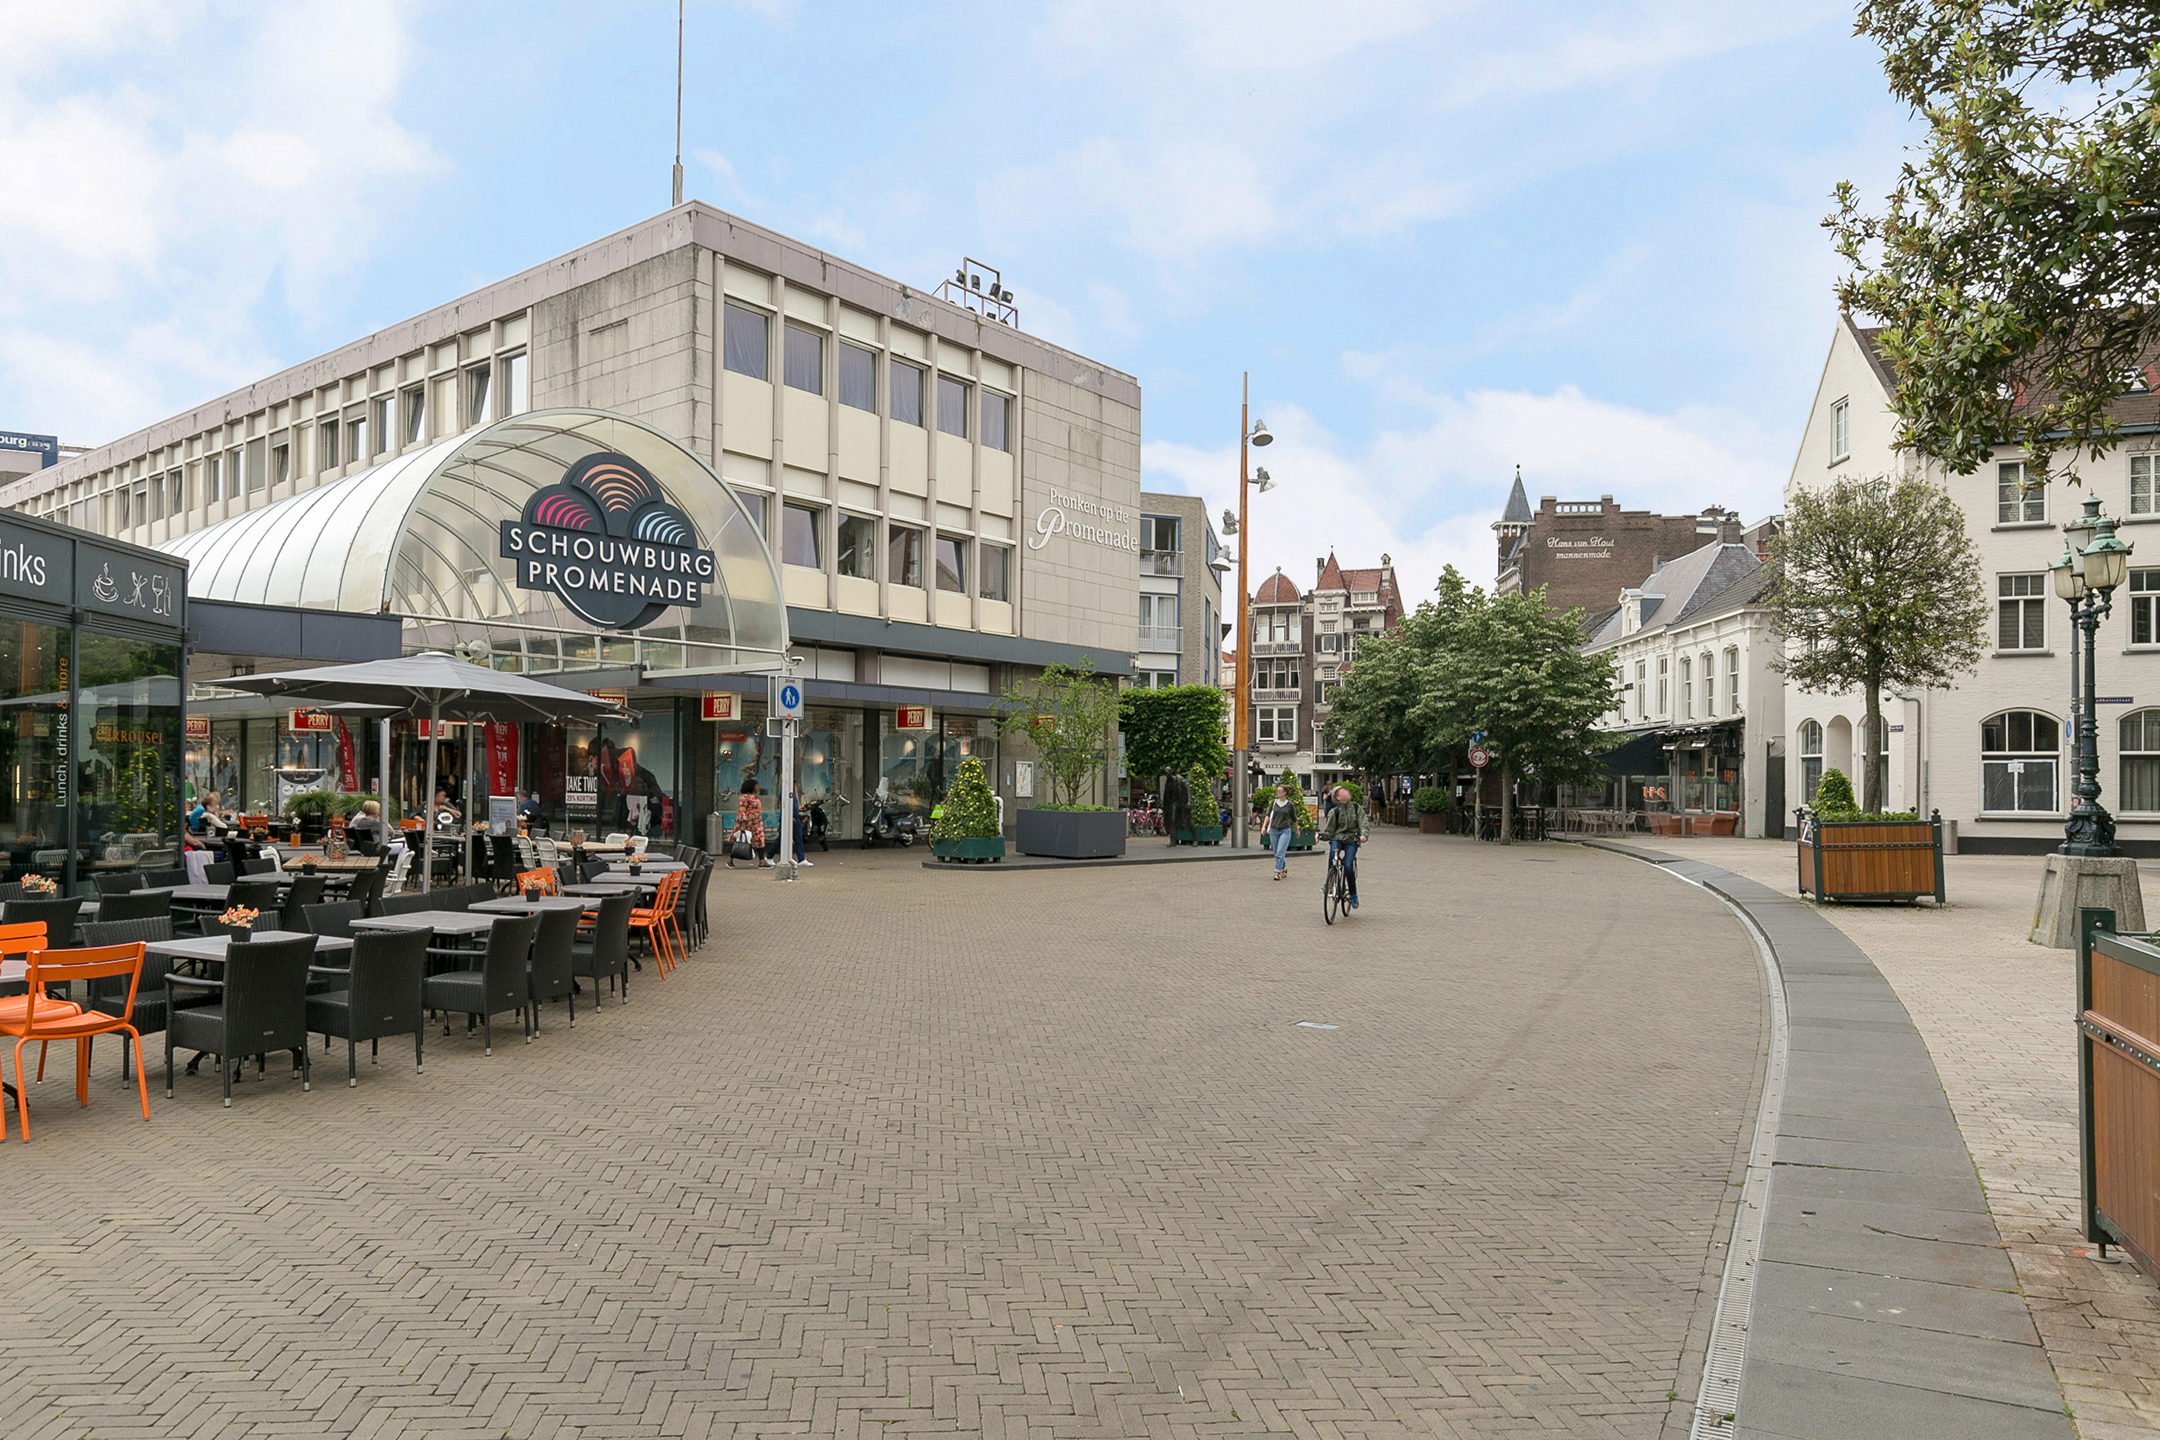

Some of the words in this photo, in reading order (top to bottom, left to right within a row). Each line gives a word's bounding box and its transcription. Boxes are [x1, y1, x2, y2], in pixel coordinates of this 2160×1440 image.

[1049, 487, 1097, 516] Pronken
[1100, 504, 1114, 523] op
[1116, 505, 1129, 524] de
[1027, 506, 1139, 552] Promenade
[1546, 536, 1572, 548] Hans
[509, 527, 713, 577] SCHOUWBURG
[1555, 548, 1612, 559] mannenmode
[528, 560, 698, 608] PROMENADE
[58, 657, 68, 693] more
[56, 700, 68, 710] &
[713, 699, 730, 714] PERRY
[186, 720, 206, 731] PERRY
[307, 714, 328, 726] PERRY
[907, 711, 924, 724] PERRY
[56, 713, 68, 756] drinks
[56, 760, 68, 808] Lunch,
[565, 776, 582, 792] TAKE
[583, 776, 598, 792] TWO
